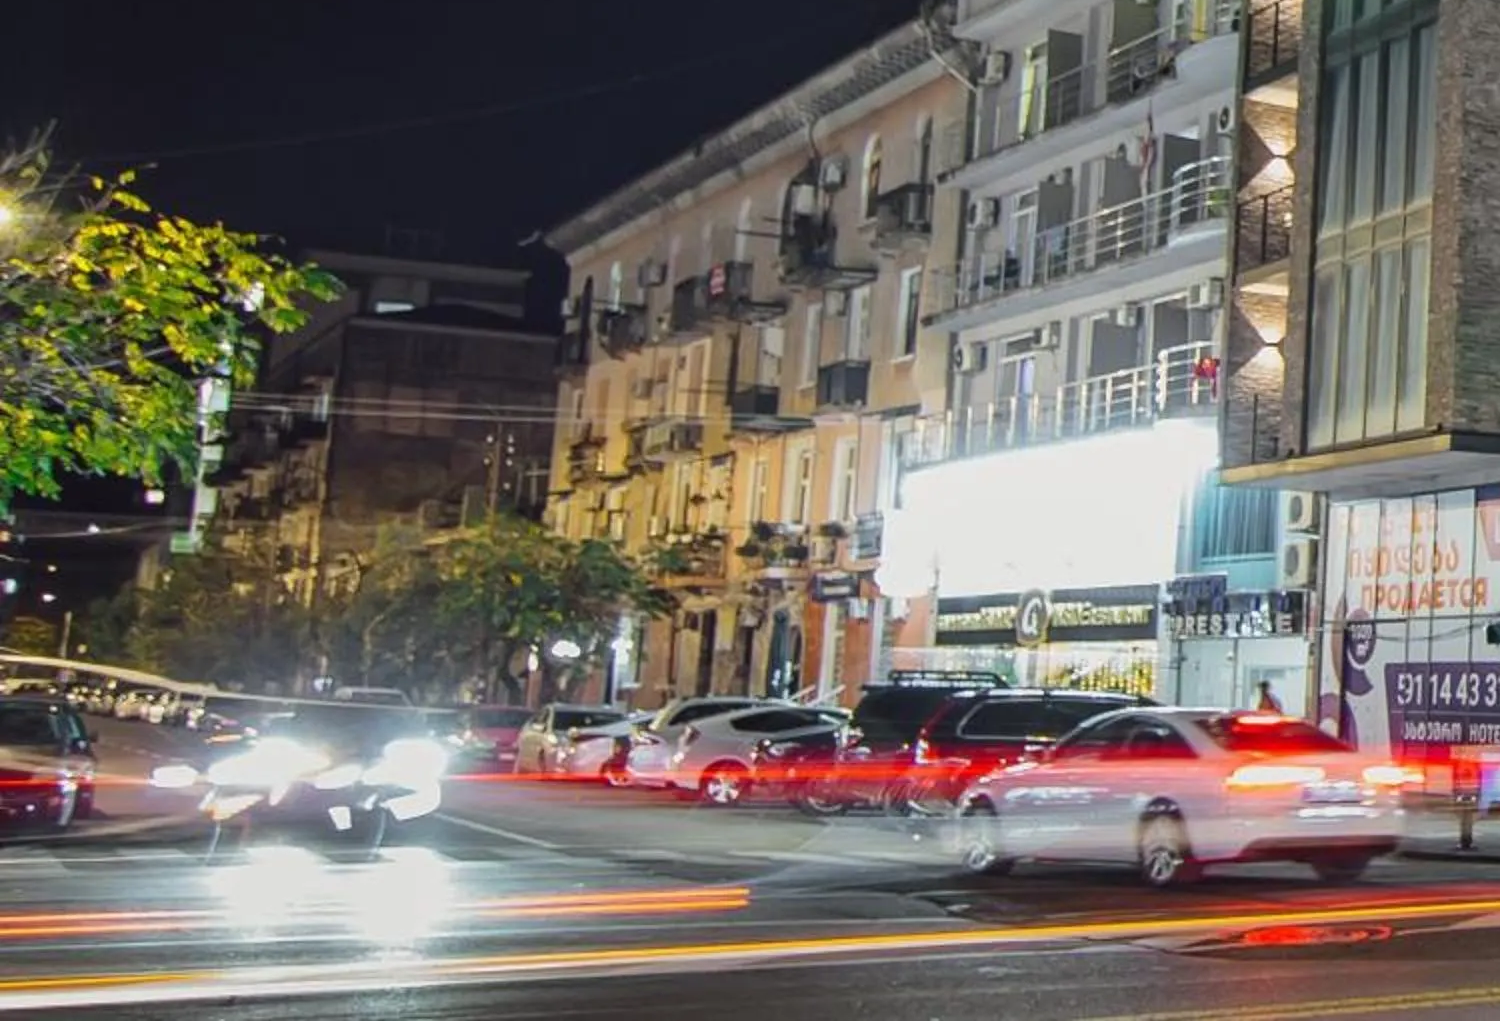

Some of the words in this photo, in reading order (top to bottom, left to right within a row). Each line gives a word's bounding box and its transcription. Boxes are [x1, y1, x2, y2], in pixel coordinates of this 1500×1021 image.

[1361, 577, 1489, 615] ПРОДАЕТСЯ
[1430, 673, 1452, 706] 14
[1456, 672, 1480, 707] 43
